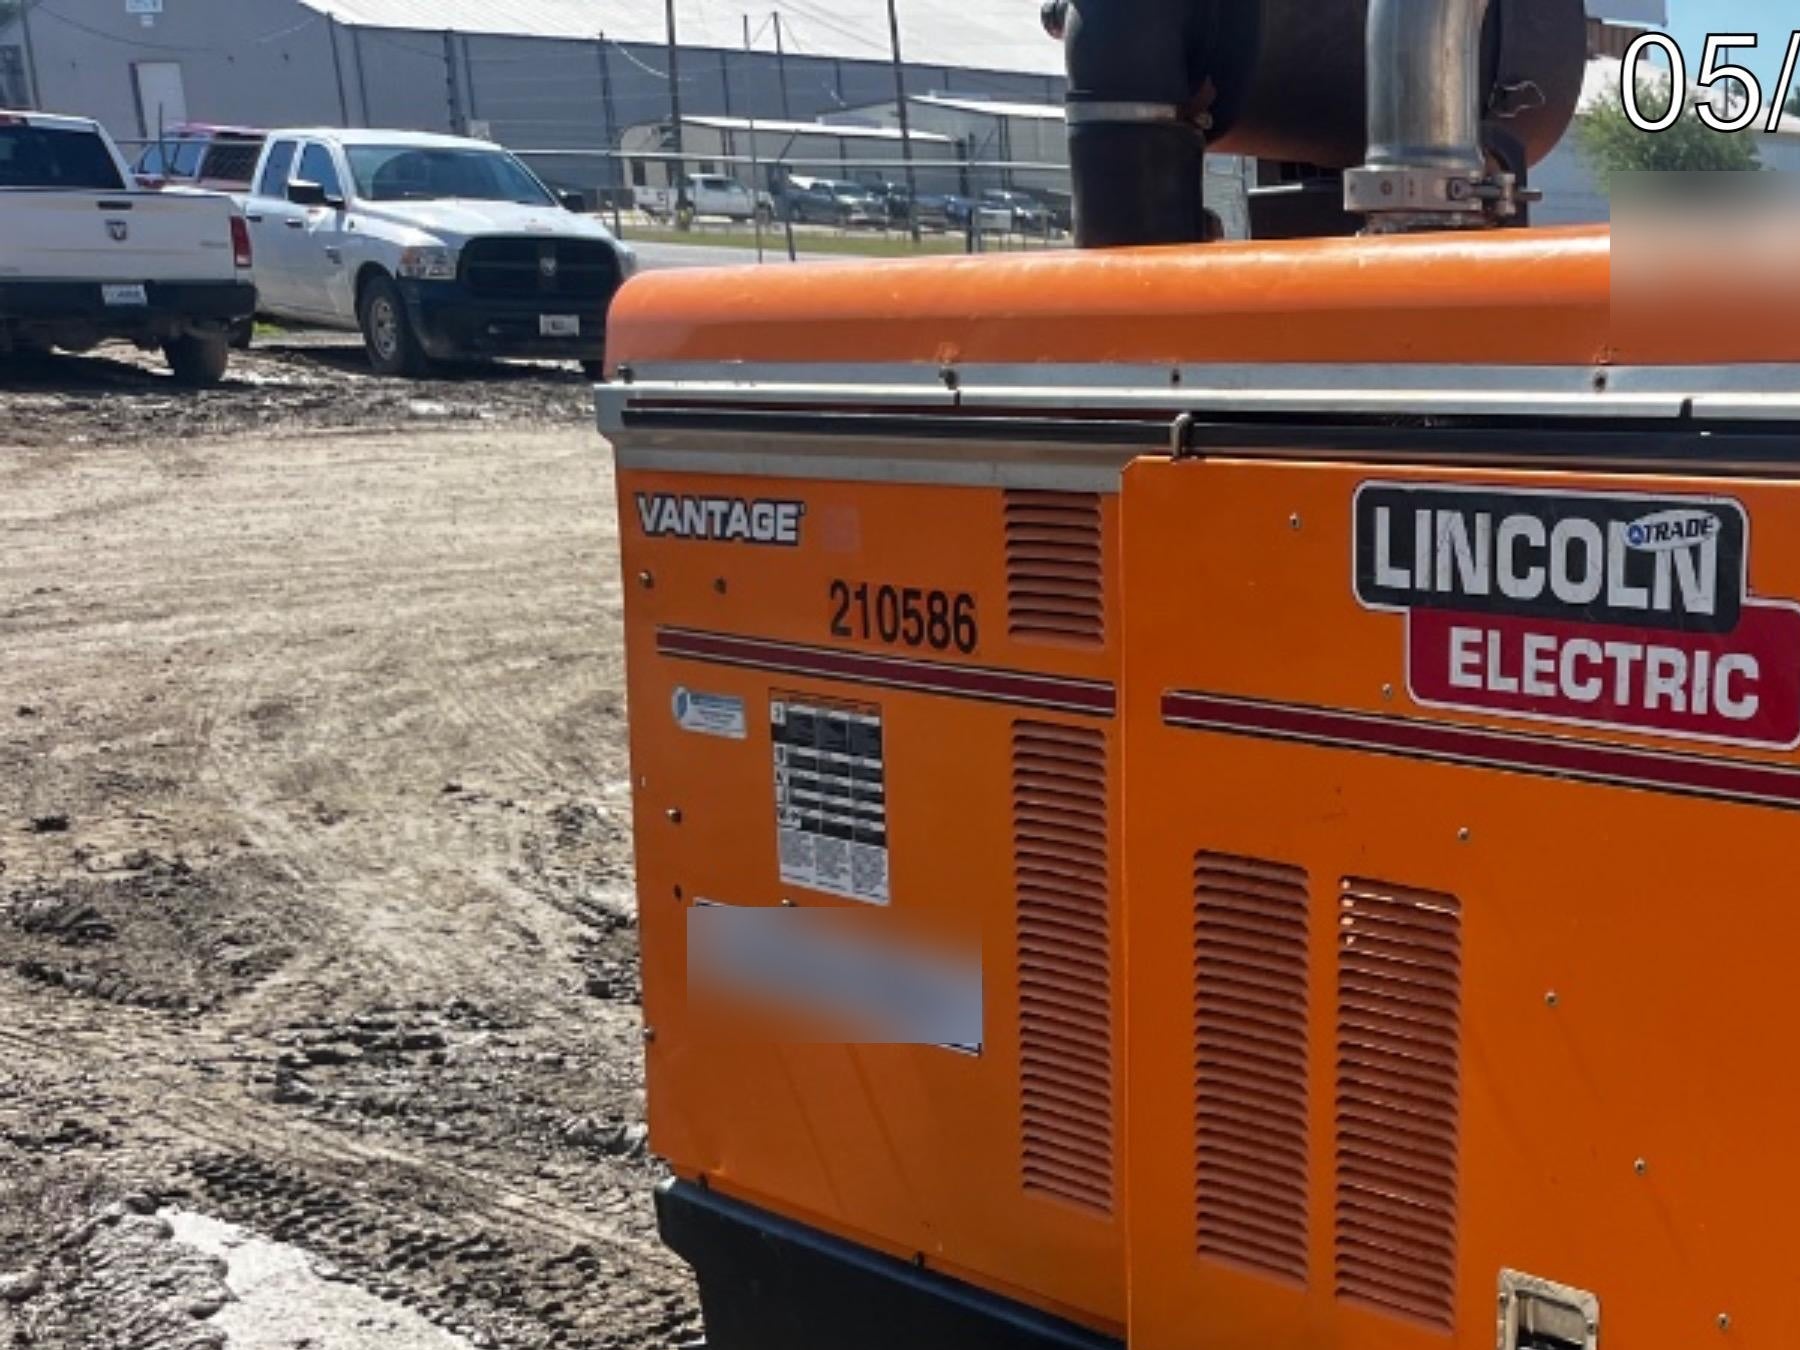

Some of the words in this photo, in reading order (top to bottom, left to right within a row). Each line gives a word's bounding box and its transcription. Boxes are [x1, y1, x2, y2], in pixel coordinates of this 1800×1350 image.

[637, 495, 799, 542] VANTAGE
[1644, 516, 1713, 543] TRADE
[1374, 506, 1717, 615] LINCOLN
[830, 579, 977, 653] 210586
[1449, 626, 1760, 720] ELECTRIC
